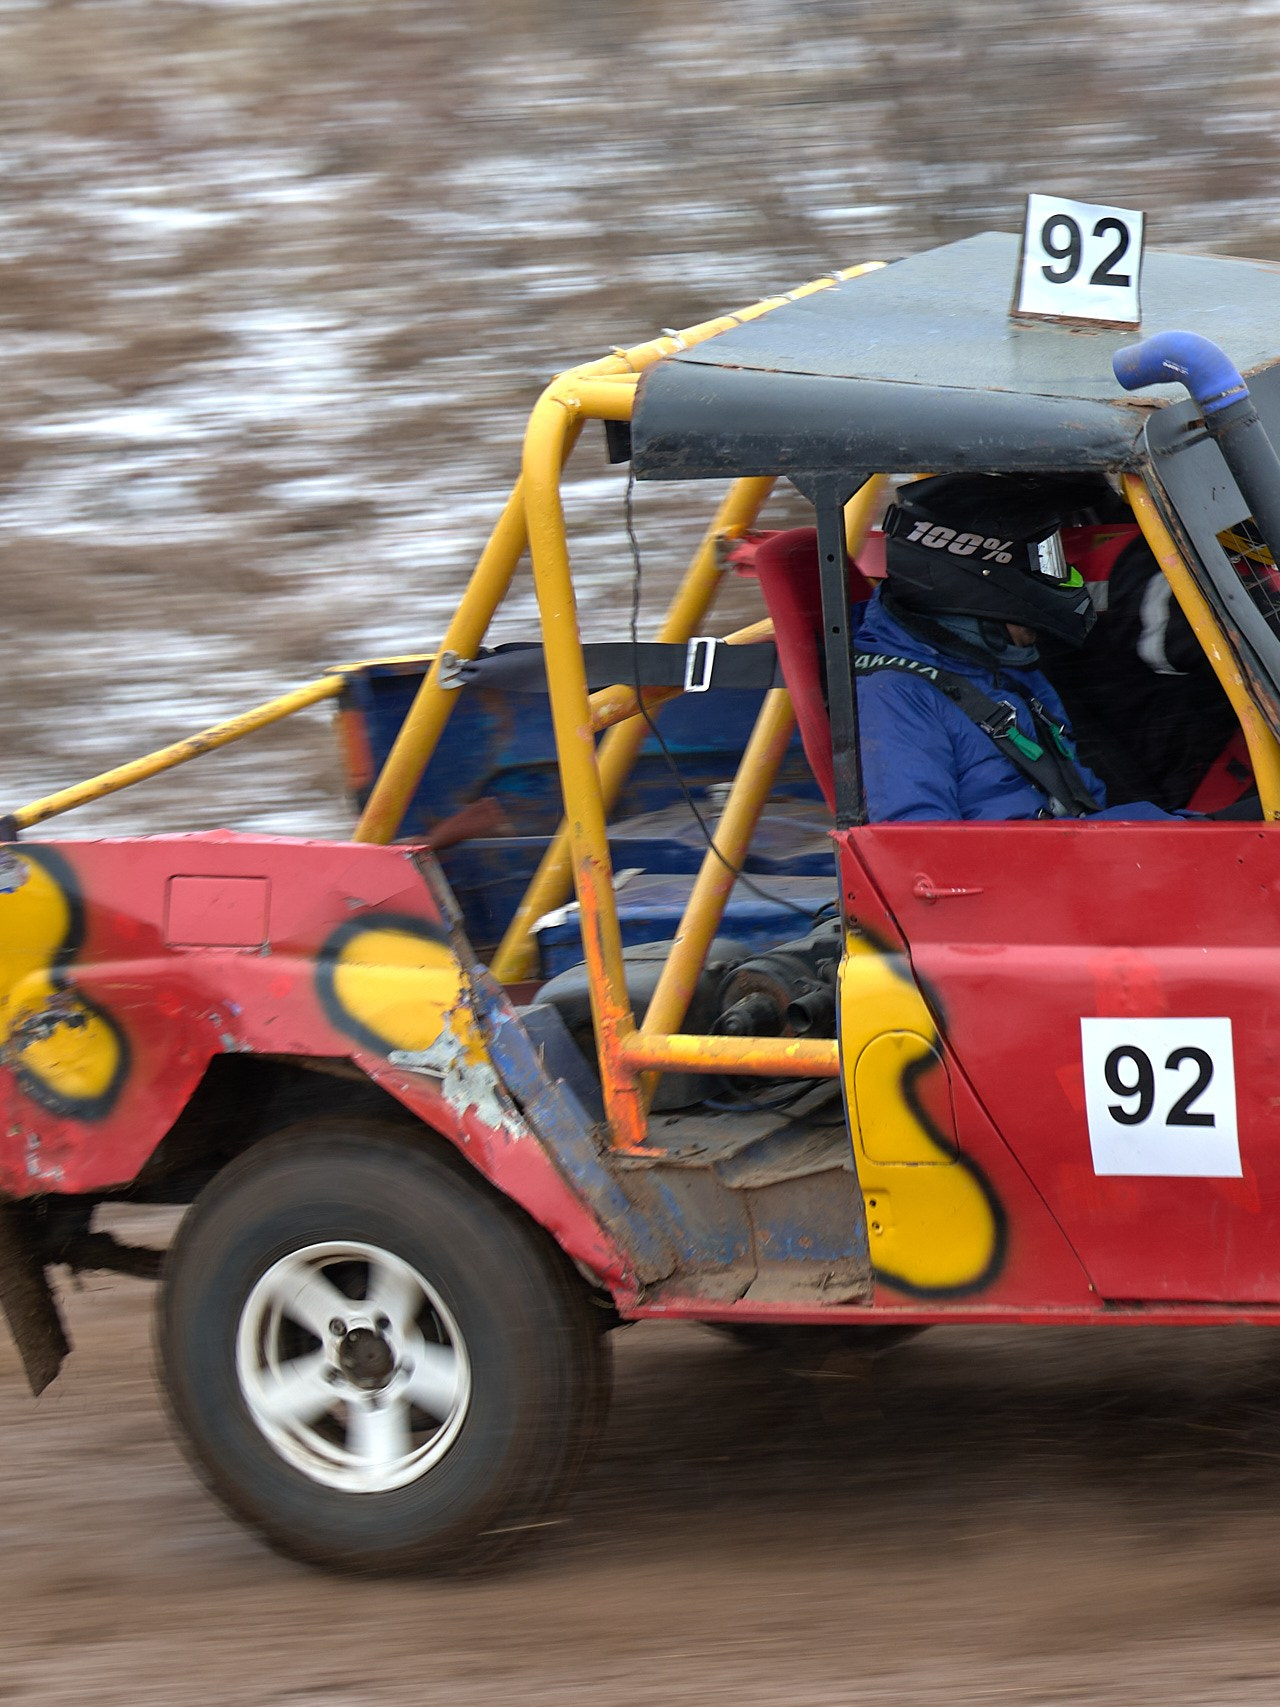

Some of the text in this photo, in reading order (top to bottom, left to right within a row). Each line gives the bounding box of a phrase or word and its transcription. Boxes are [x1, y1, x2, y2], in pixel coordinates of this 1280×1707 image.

[1041, 213, 1131, 287] 92
[906, 521, 1014, 563] 100%
[855, 654, 938, 680] AKATA
[1104, 1044, 1216, 1128] 92
